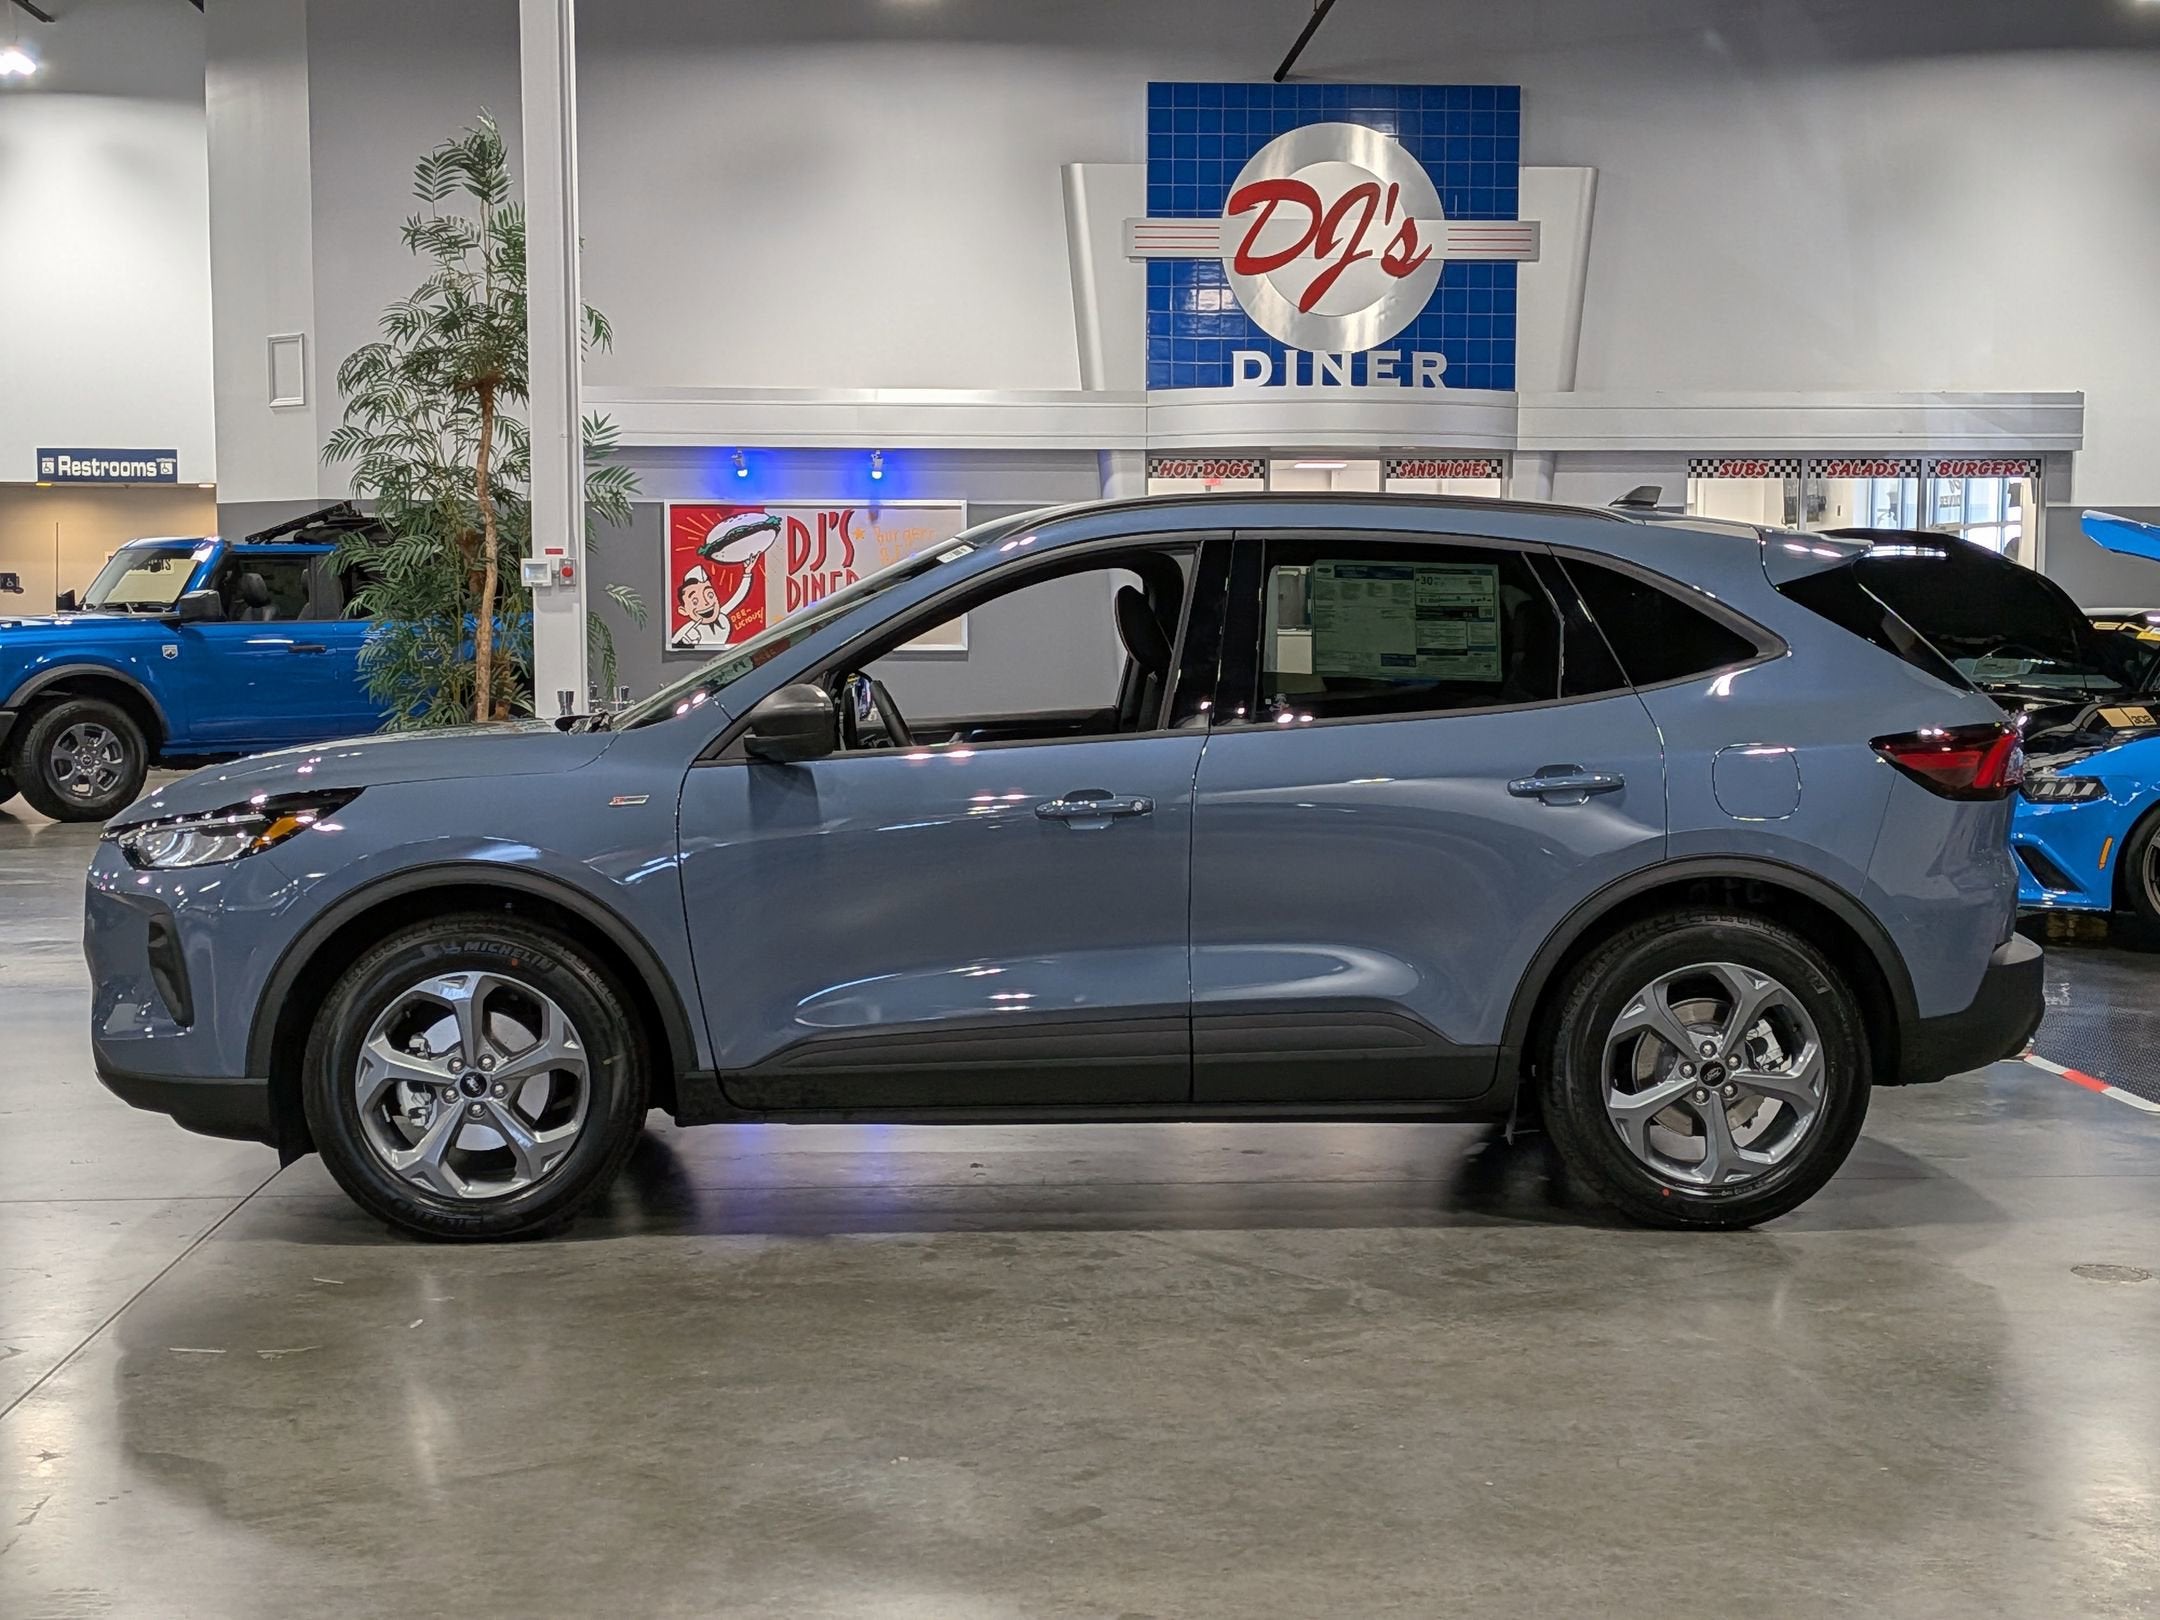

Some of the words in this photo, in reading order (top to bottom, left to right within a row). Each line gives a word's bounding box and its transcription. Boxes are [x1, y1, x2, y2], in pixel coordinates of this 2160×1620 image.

[1228, 178, 1433, 314] DJ's
[1231, 349, 1448, 389] DINER
[57, 455, 158, 477] Restrooms
[1160, 462, 1198, 477] HOT
[1202, 462, 1252, 477] DOGS
[1400, 462, 1488, 477] SANDWICHES
[1719, 462, 1768, 476] SUBS
[1826, 462, 1900, 476] SALADS
[1939, 461, 2027, 475] BURGERS
[787, 508, 855, 577] DJ'S
[464, 941, 553, 970] MICHELIN
